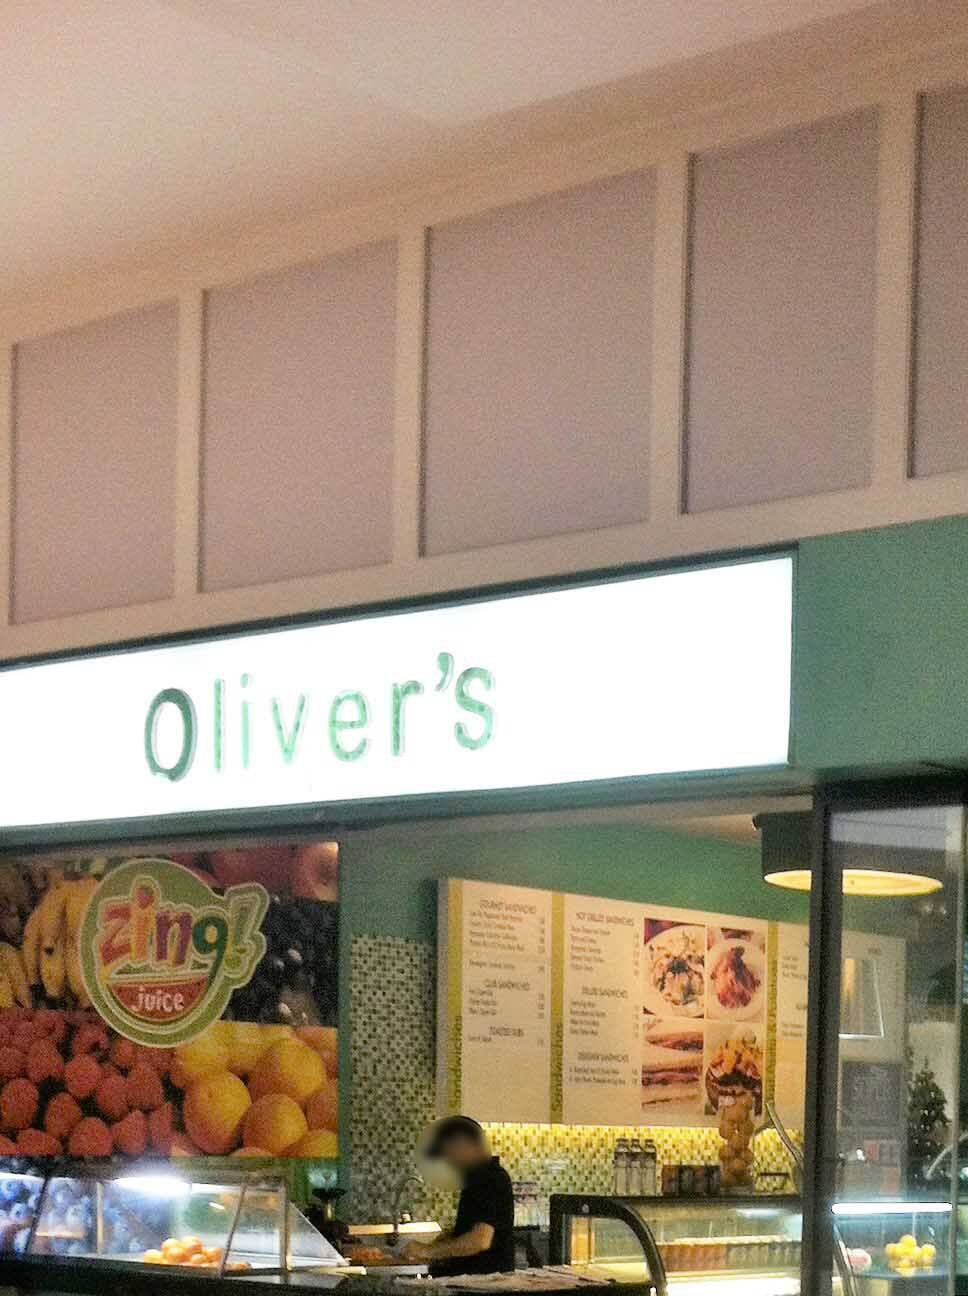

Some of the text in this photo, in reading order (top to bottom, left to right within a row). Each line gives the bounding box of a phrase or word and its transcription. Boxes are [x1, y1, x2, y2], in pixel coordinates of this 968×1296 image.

[144, 652, 497, 782] Oliver's
[131, 985, 185, 1013] juice
[448, 1016, 462, 1109] Sandwiches
[551, 1023, 563, 1112] Sandwiches
